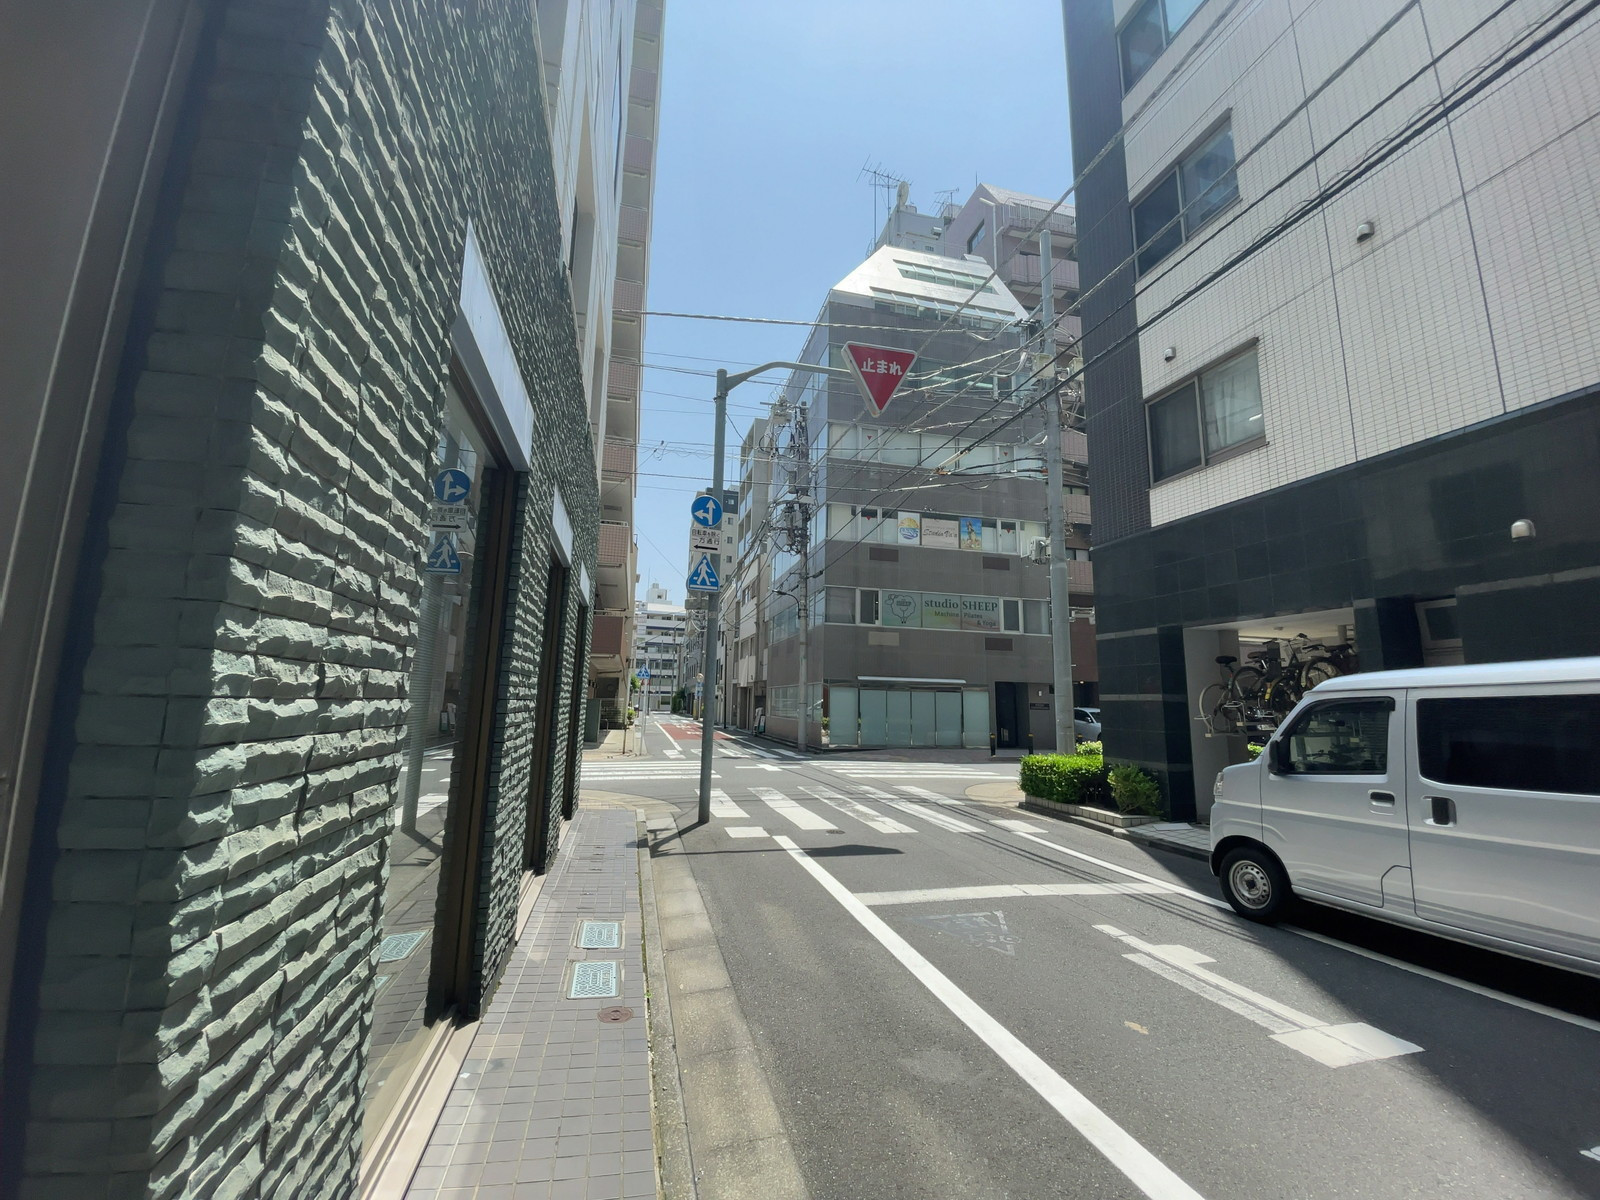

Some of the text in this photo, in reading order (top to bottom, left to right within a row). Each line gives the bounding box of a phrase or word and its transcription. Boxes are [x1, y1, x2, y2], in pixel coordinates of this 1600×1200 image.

[861, 358, 903, 376] 止まれ
[923, 528, 944, 537] Studio
[692, 537, 720, 546] 一方通行
[924, 598, 959, 609] studio
[962, 600, 998, 612] SHEEP
[934, 610, 960, 618] Machine
[982, 620, 996, 628] Yoga
